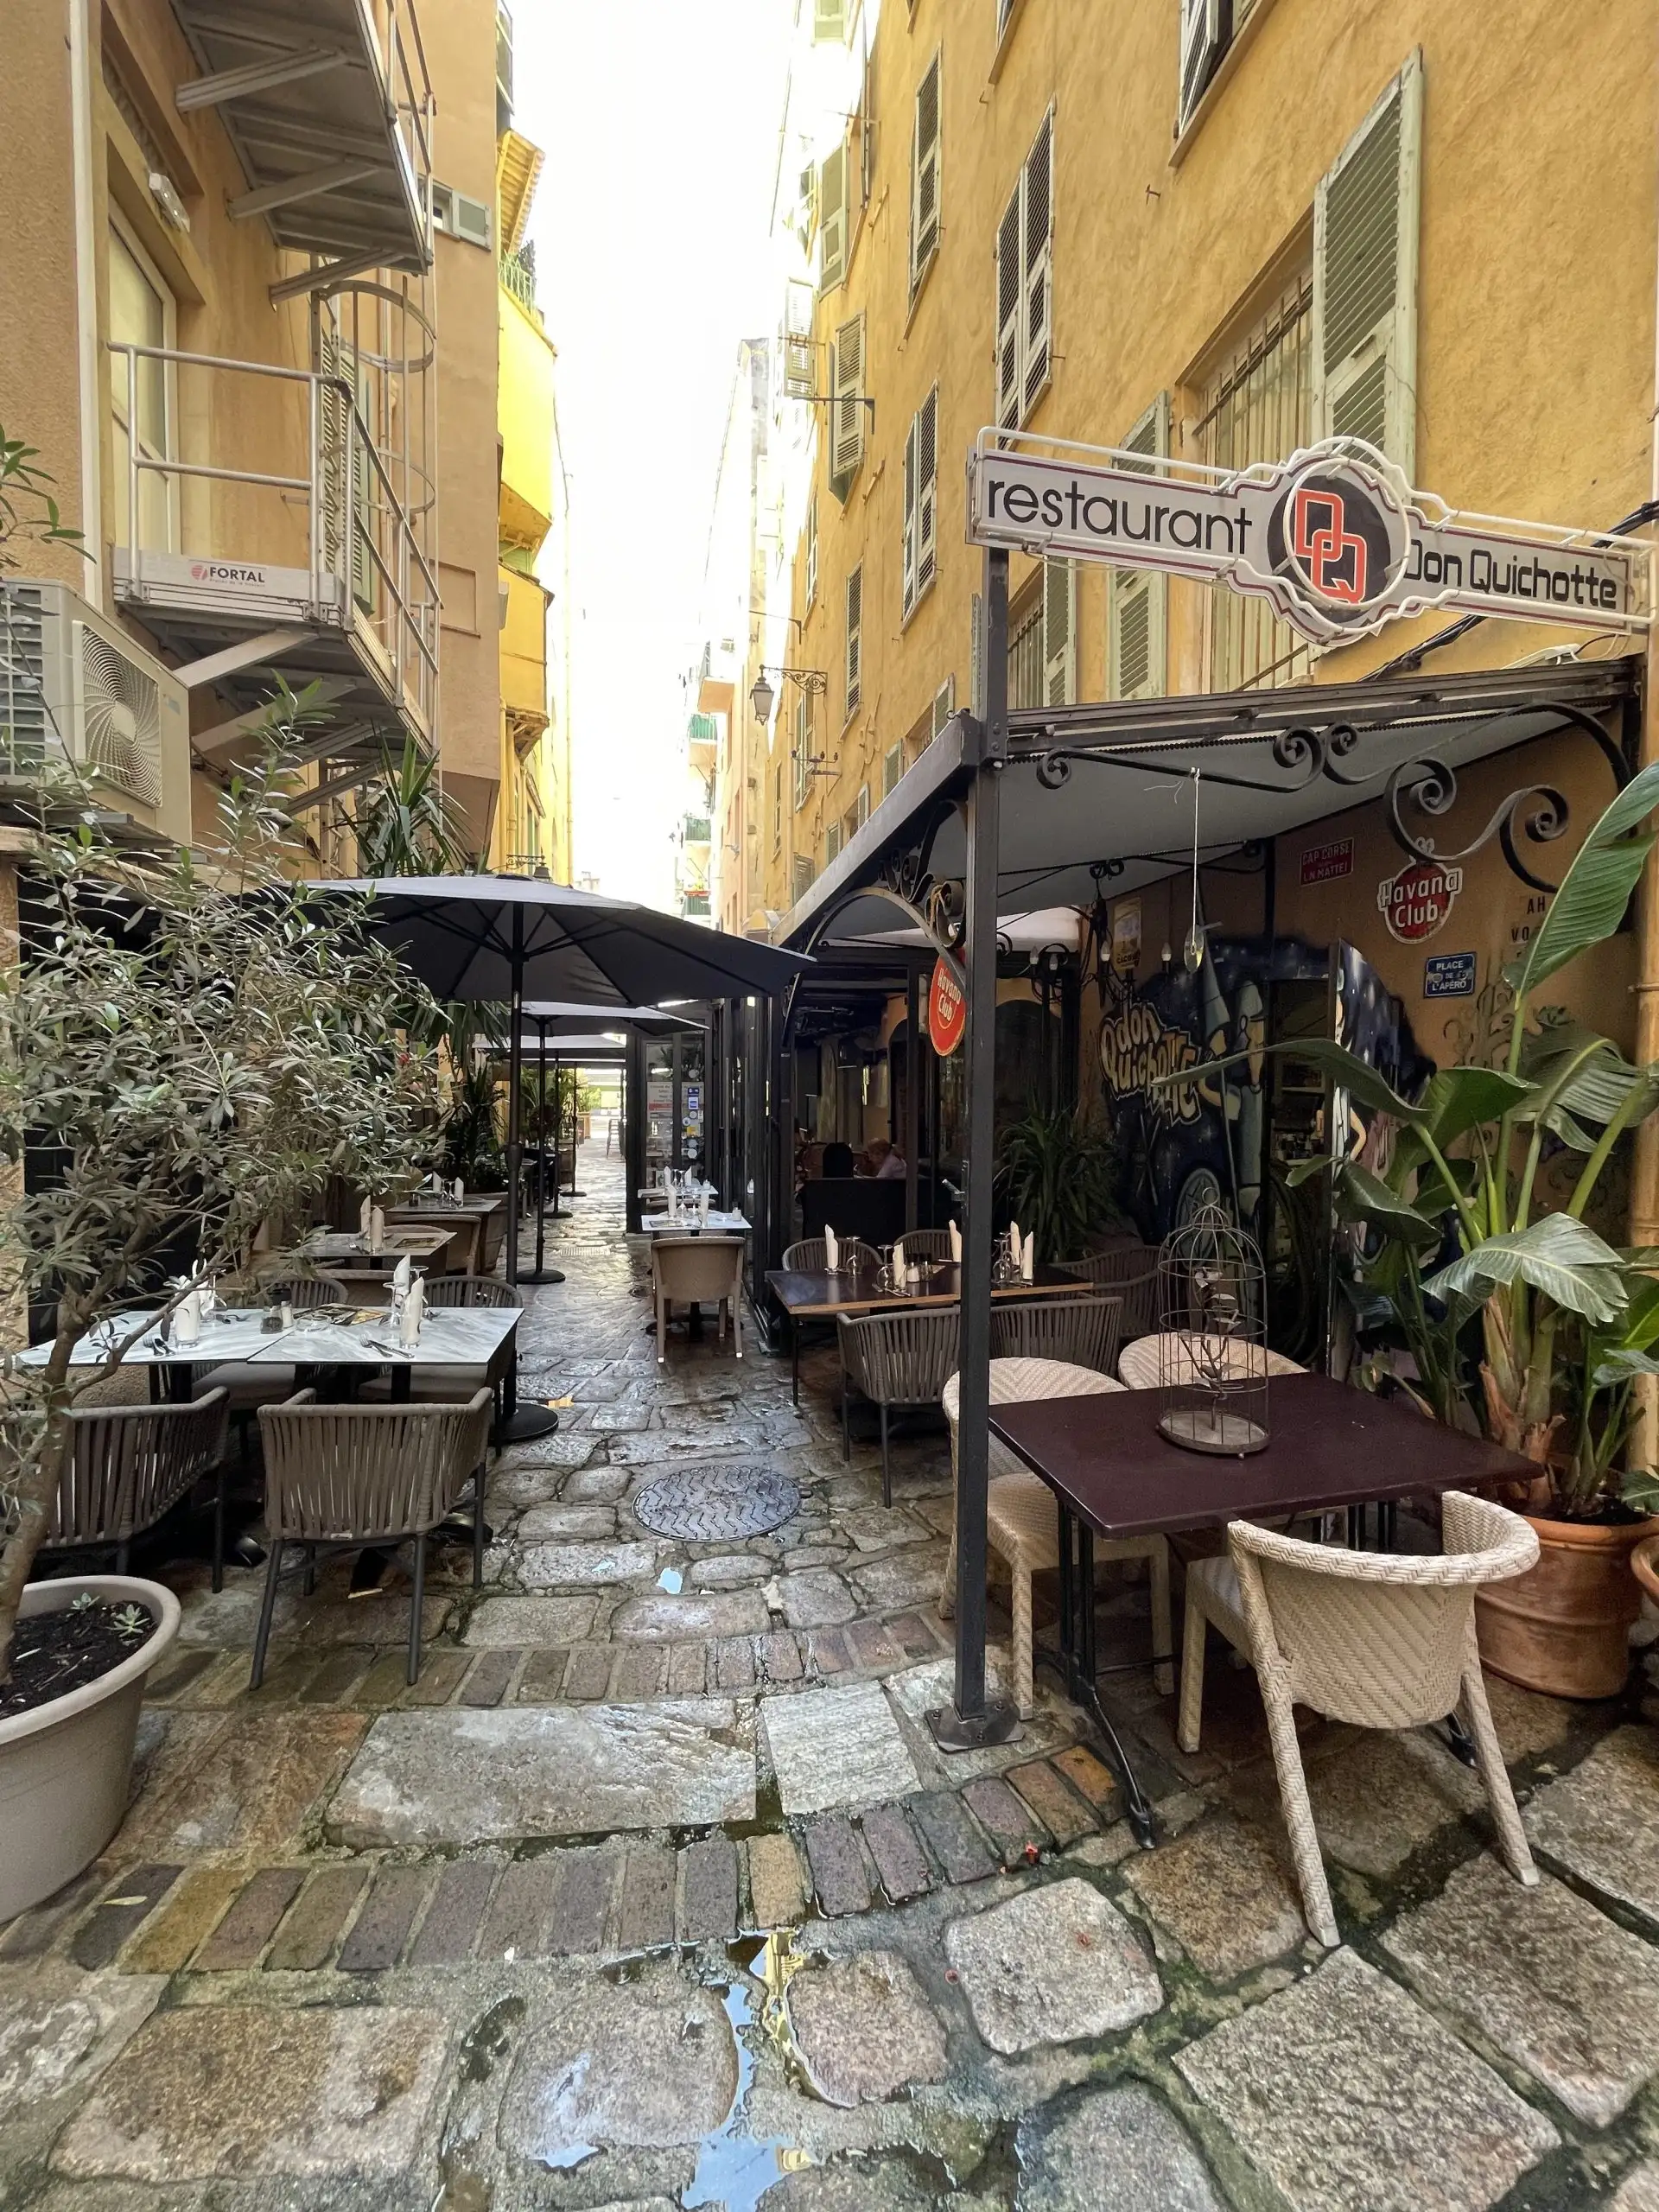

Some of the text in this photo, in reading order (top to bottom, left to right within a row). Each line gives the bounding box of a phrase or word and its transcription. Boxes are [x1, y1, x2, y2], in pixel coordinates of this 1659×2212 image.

[988, 480, 1253, 555] restaurant
[209, 566, 265, 583] FORTAL
[1470, 548, 1618, 609] Quichotte
[1302, 842, 1351, 866] CAP CORSE
[1317, 861, 1348, 880] MATTEI
[1382, 871, 1459, 907] Havana
[1395, 899, 1439, 928] Club
[1436, 960, 1465, 971] PLACE
[937, 967, 962, 1006] Havana
[938, 992, 953, 1022] Club
